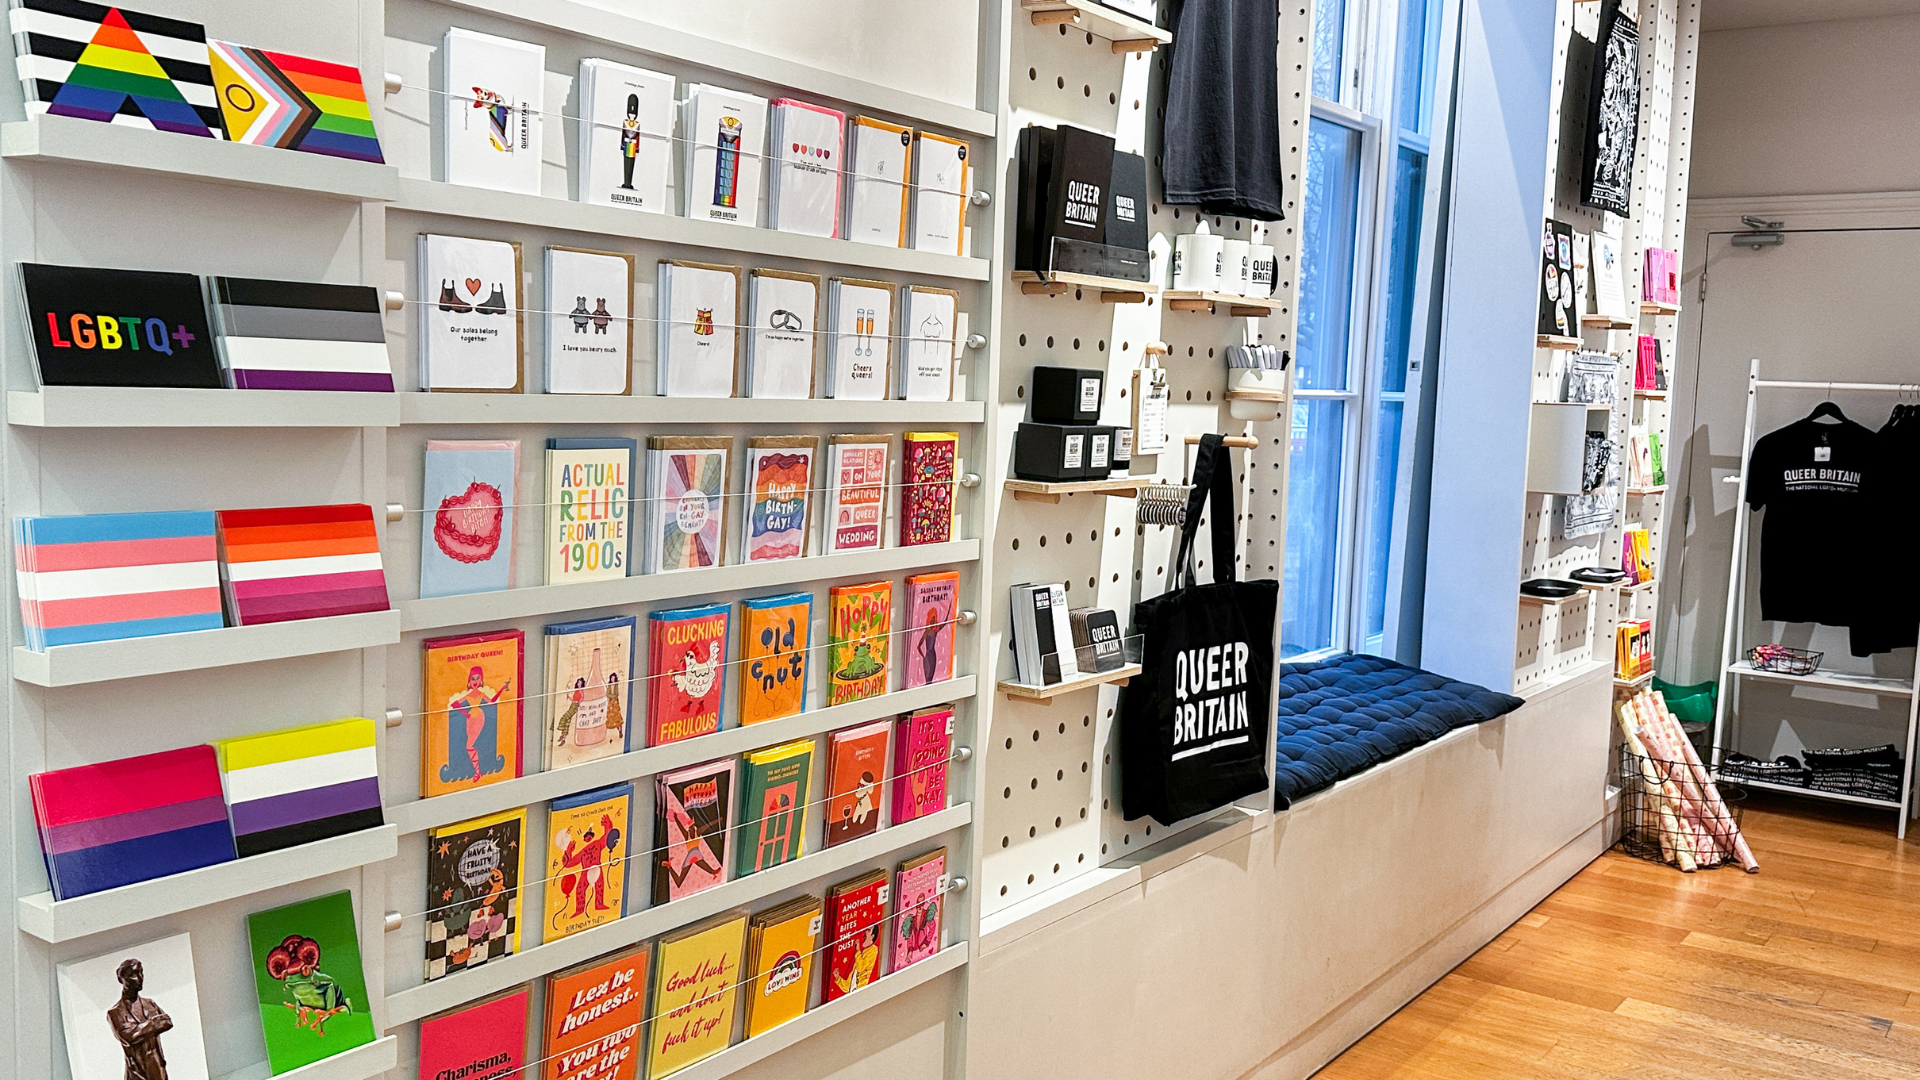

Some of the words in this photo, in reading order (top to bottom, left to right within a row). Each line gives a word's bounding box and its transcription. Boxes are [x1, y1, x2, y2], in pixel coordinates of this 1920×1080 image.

[1068, 180, 1100, 205] QUEER
[1116, 195, 1135, 209] QUEER
[1066, 201, 1098, 222] BRITAIN
[1116, 205, 1135, 219] BRITAIN
[1253, 260, 1272, 272] QUEE
[46, 312, 195, 356] LGBTQ+
[479, 327, 498, 336] belong
[851, 371, 873, 380] queers!
[853, 363, 872, 372] Cheers
[561, 463, 624, 487] ACTUAL
[854, 472, 863, 480] ON
[867, 470, 881, 479] YOUR
[1784, 468, 1816, 481] QUEER
[1819, 468, 1861, 483] BRITAIN
[768, 483, 797, 500] HAPPY
[841, 488, 880, 501] BEAUTIFUL
[560, 487, 624, 521] RELIC
[855, 508, 876, 521] QUEER
[560, 522, 596, 542] FROM
[600, 521, 623, 539] THE
[767, 517, 791, 530] GAY!
[838, 531, 875, 544] WEDDING
[667, 619, 724, 645] CLUCKING
[1092, 625, 1116, 642] QUEER
[1094, 641, 1120, 655] BRITAIN
[447, 653, 479, 663] BIRTHDAY
[1175, 641, 1249, 701] QUEER
[835, 676, 883, 704] BIRTHDAY
[660, 712, 717, 741] FABULOUS
[918, 719, 934, 735] IT'S
[1173, 691, 1249, 746] BRITAIN
[924, 733, 940, 747] ALL
[915, 746, 946, 763] GOING
[929, 776, 940, 788] BE
[916, 789, 942, 806] OKAY
[467, 847, 486, 858] HAVE
[487, 845, 492, 853] A
[467, 857, 492, 870] FRUITY
[466, 867, 491, 879] BIRTHDAY
[842, 895, 872, 913] ANOTHER
[841, 910, 858, 922] YEAR
[840, 920, 857, 933] BITES
[838, 939, 855, 952] DUST
[610, 968, 635, 988] be
[666, 962, 702, 993] Good
[768, 977, 784, 990] LOVE
[785, 971, 800, 981] WINS
[669, 991, 697, 1019] and
[661, 1023, 689, 1054] fuck
[691, 1016, 705, 1039] it
[704, 1008, 725, 1038] up!
[435, 1052, 511, 1080] Charisma,
[560, 1043, 600, 1076] You
[567, 1064, 597, 1080] re
[599, 1046, 630, 1073] the
